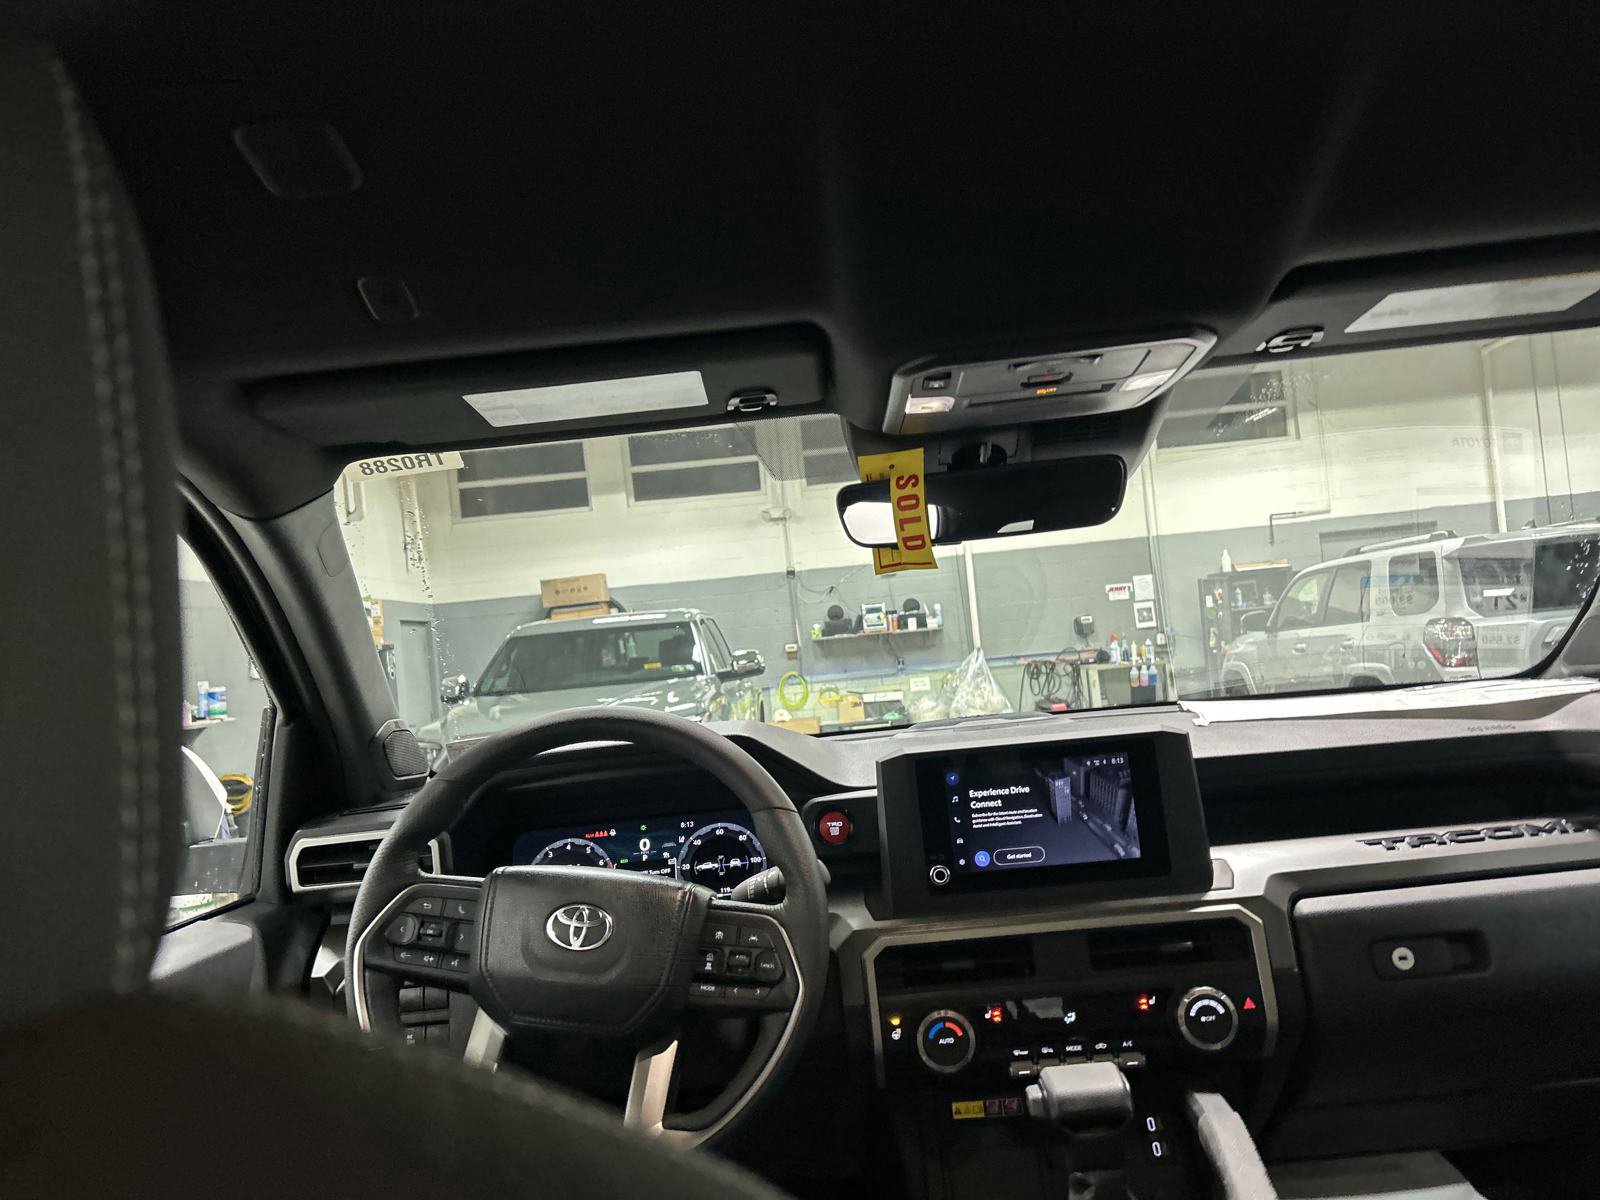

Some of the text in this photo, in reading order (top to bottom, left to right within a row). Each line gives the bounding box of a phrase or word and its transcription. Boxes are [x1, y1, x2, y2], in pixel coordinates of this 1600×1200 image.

[895, 473, 927, 551] SOLD
[969, 786, 1030, 798] Experience Drive
[970, 799, 1002, 809] Connect
[639, 838, 651, 851] 0
